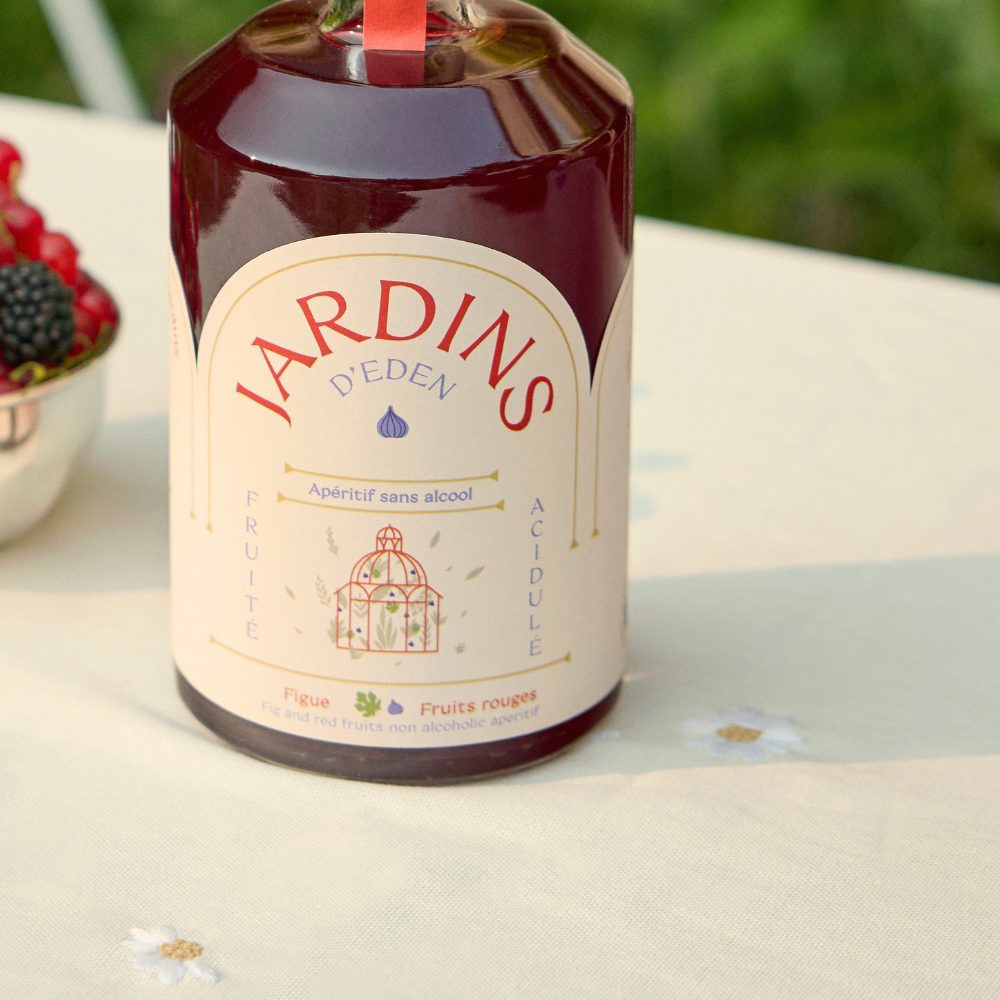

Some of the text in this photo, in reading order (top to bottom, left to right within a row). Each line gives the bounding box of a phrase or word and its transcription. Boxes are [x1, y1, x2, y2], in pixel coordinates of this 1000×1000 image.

[235, 279, 554, 432] JARDINS
[328, 358, 457, 401] D’EDEN
[308, 483, 473, 503] Apéritif sans alcool
[244, 489, 259, 640] FRUITÉ
[528, 497, 545, 657] ACIDULÉ
[283, 686, 331, 708] Figue
[420, 689, 538, 716] Fruits rouges
[261, 700, 281, 717] Fig
[284, 709, 310, 723] and
[313, 714, 338, 728] red
[341, 717, 384, 733] fruits
[388, 723, 418, 734] non
[421, 718, 486, 734] alcoholic
